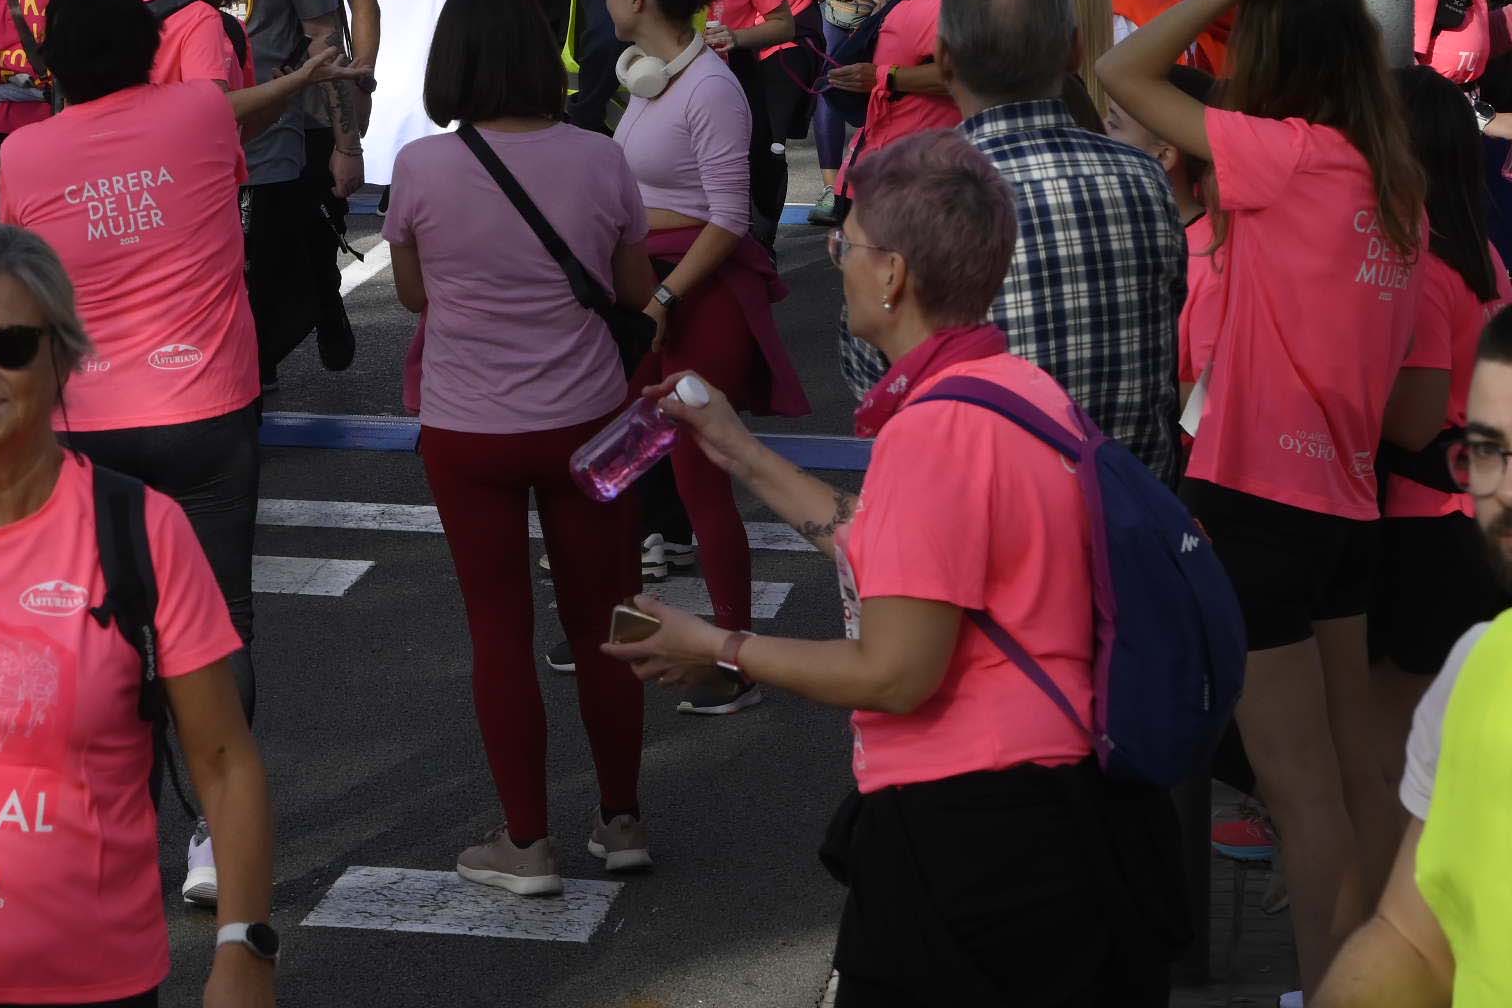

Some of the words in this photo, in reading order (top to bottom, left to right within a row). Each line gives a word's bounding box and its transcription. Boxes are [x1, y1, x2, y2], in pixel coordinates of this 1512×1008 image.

[64, 165, 175, 206] CARRERA
[87, 201, 121, 222] DE
[127, 190, 157, 214] LA
[87, 209, 166, 242] MUJER
[119, 235, 140, 247] 2023
[153, 353, 199, 365] ASTURIANA
